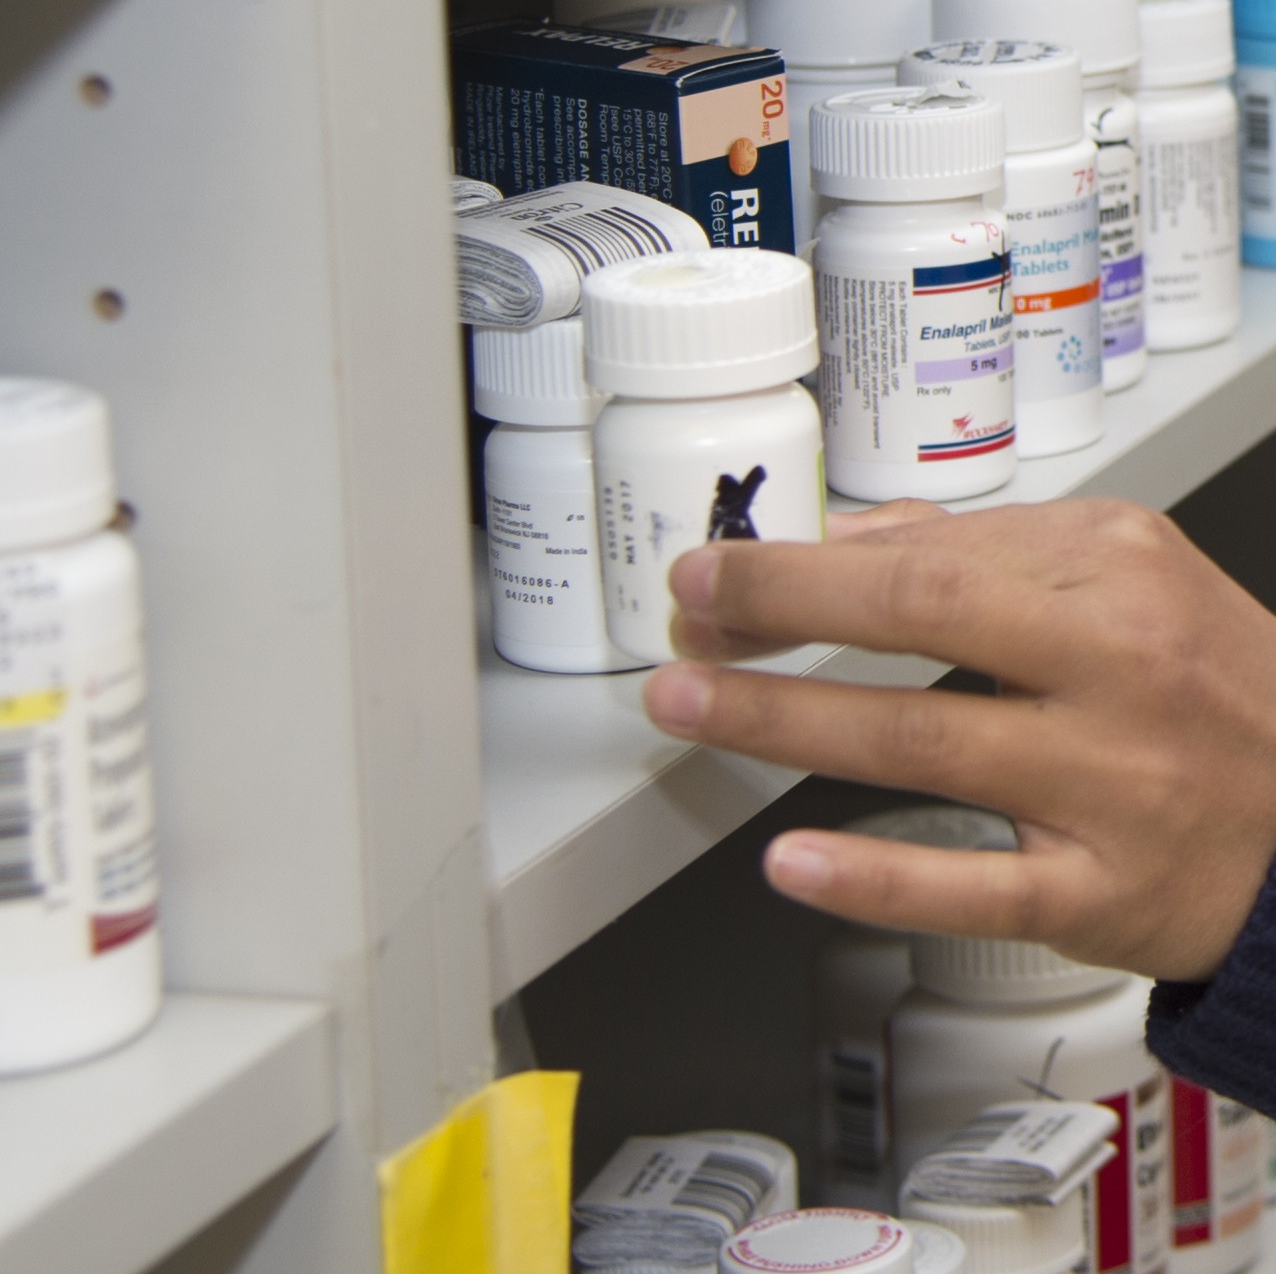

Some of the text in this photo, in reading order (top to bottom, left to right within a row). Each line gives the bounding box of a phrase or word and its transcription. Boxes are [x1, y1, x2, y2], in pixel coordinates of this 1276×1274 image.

[566, 97, 576, 121] See
[760, 80, 784, 119] 20
[496, 87, 505, 170] Manufactured by
[510, 88, 522, 191] 20 mg eletriptan.
[522, 90, 534, 176] hydrobromide
[552, 95, 563, 164] prescribing
[578, 98, 589, 159] DOSAGE
[599, 103, 609, 143] Room
[609, 105, 623, 164] [see USP
[623, 108, 635, 176] 15°C to 30°C
[633, 108, 646, 170] permitted
[645, 110, 657, 141] (68°F
[468, 130, 477, 176] IRELAND
[536, 127, 546, 161] tablet
[648, 143, 656, 155] to
[659, 112, 672, 199] Store at 20°C
[510, 202, 583, 221] Citron
[709, 191, 729, 247] (eletr
[731, 188, 759, 249] RE
[1006, 211, 1033, 222] NDC
[1011, 258, 1069, 276] Tablets
[859, 280, 867, 331] temperatures
[887, 288, 895, 301] mg
[1029, 297, 1052, 311] mg
[879, 281, 889, 397] PROTECT FROM MOISTURE.
[889, 303, 897, 336] enalapril
[899, 281, 908, 363] Each Tablet Contains
[920, 319, 987, 341] Enalapril
[965, 338, 996, 353] Tablets,
[971, 358, 997, 371] 5 mg
[891, 372, 899, 391] USP
[917, 386, 951, 396] Rx only
[620, 480, 636, 565] MAY 2017
[546, 547, 562, 555] Made
[572, 547, 588, 555] India
[505, 589, 554, 605] 04/2018
